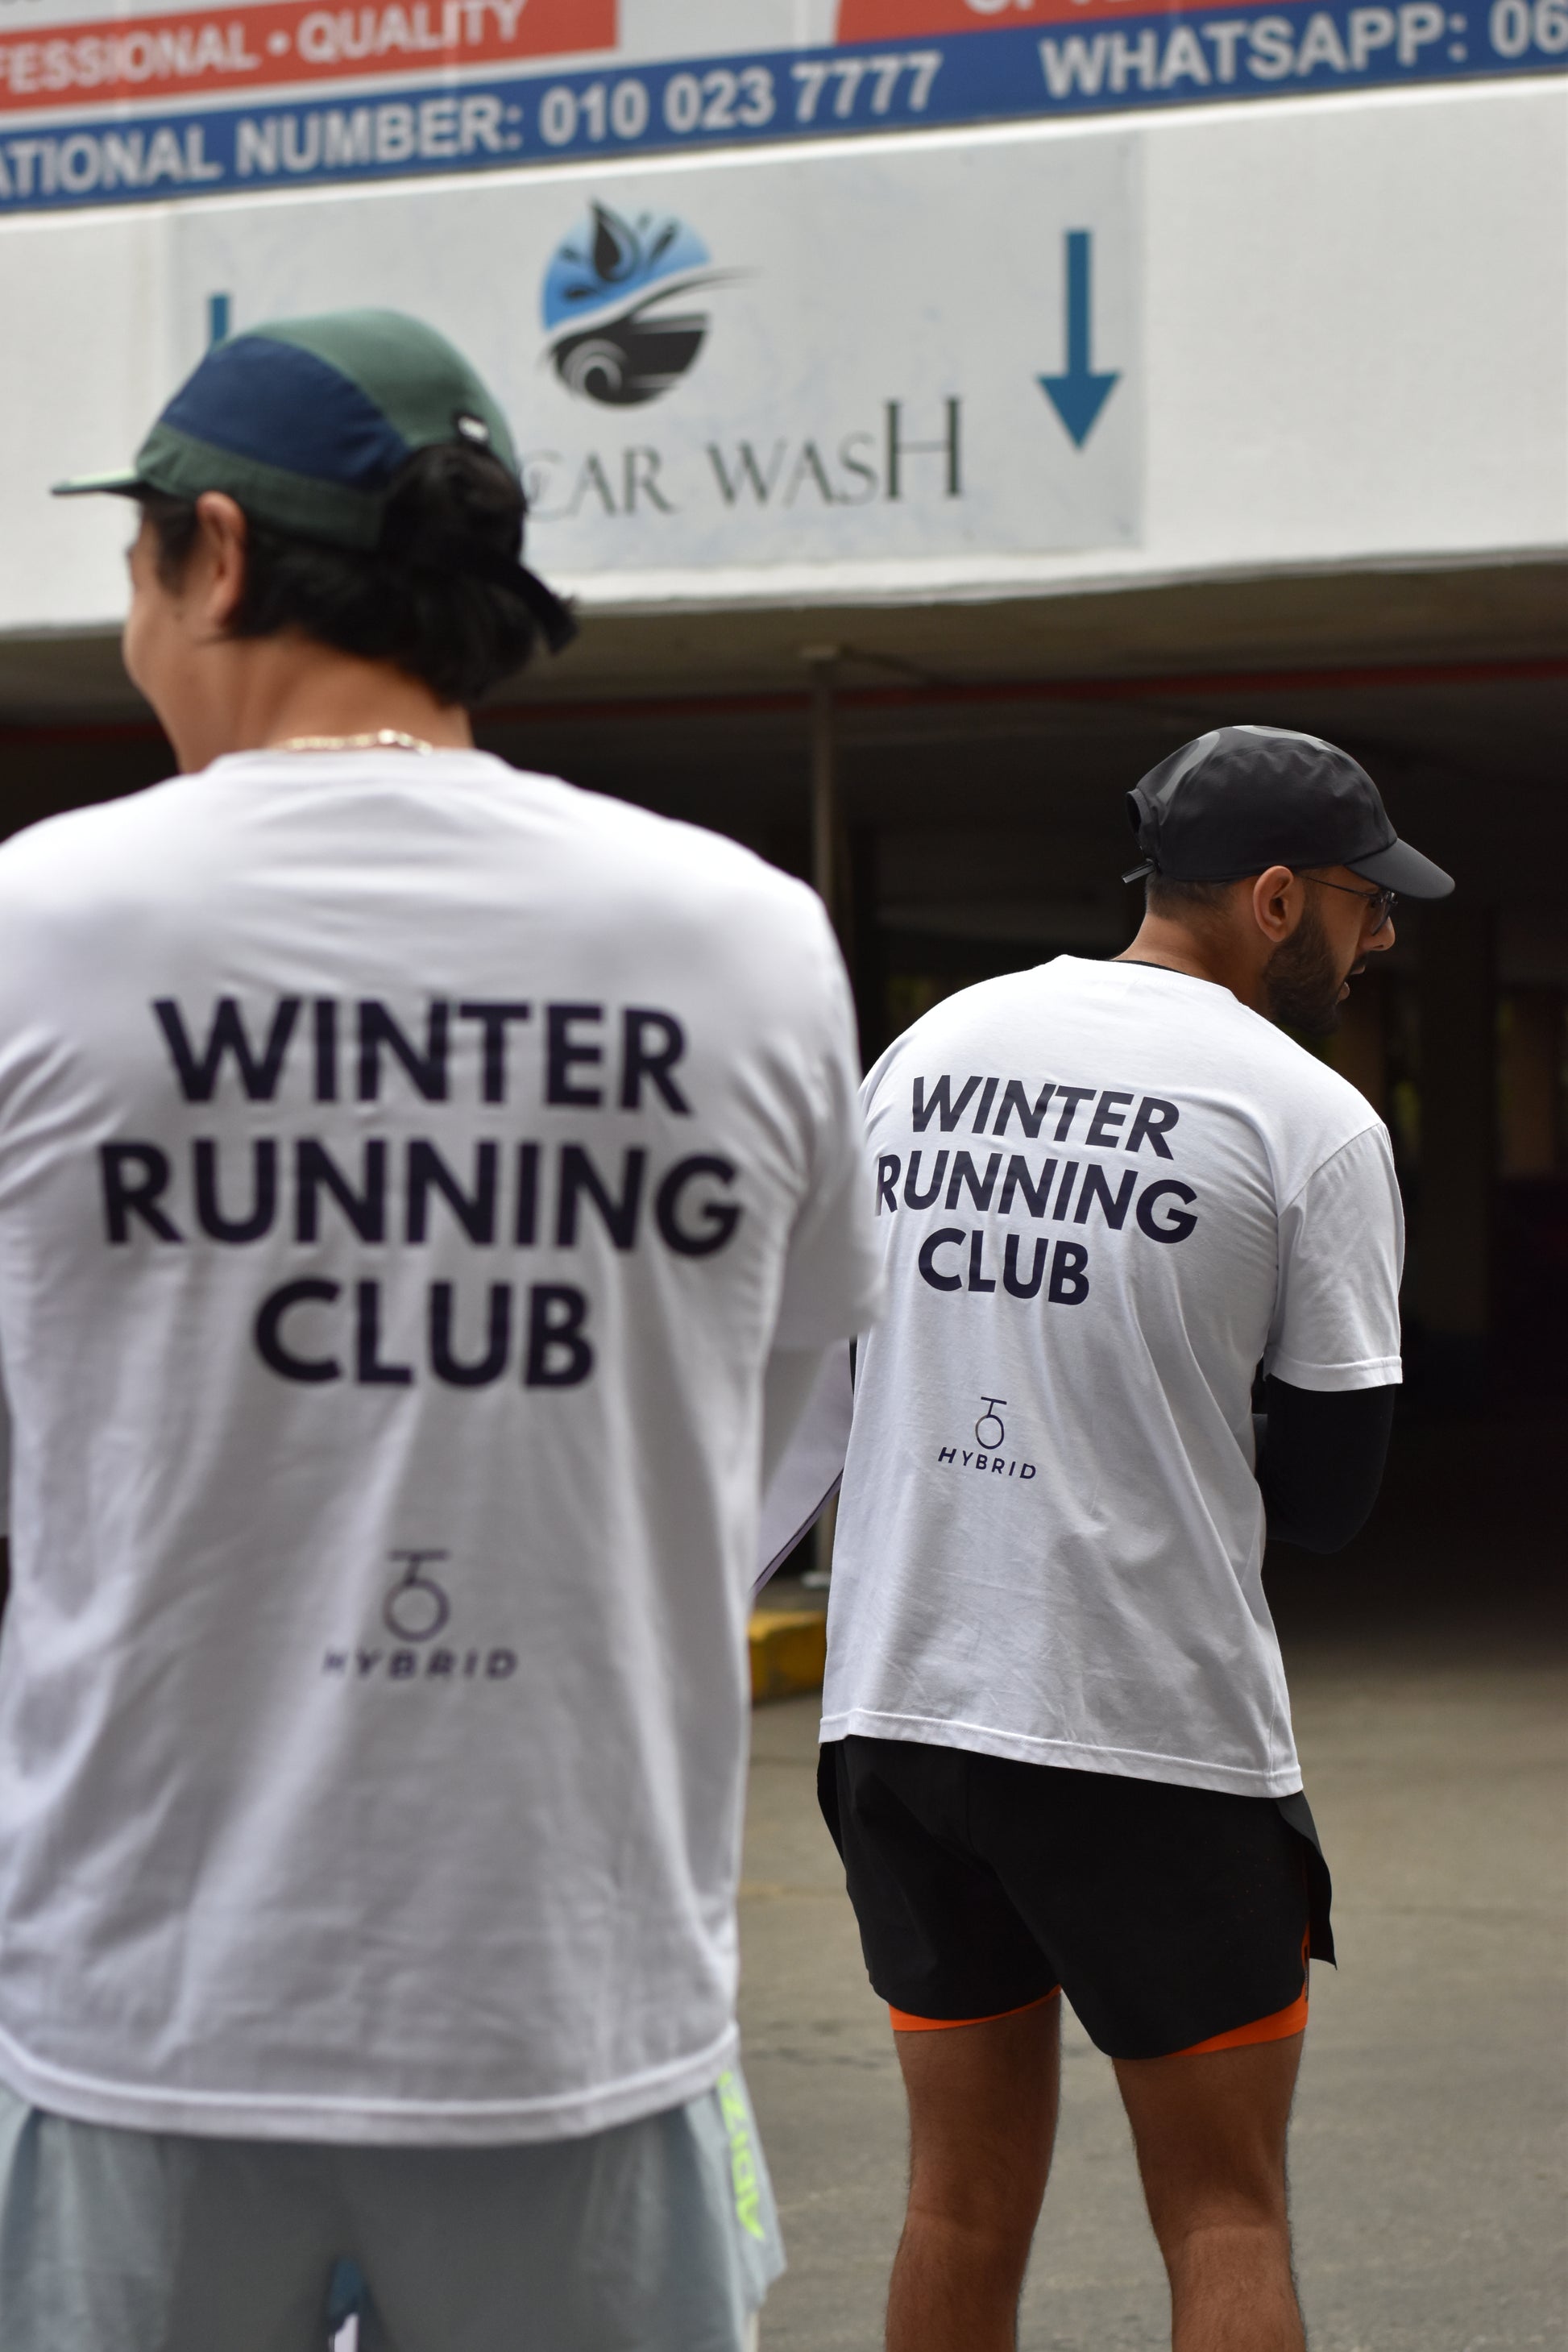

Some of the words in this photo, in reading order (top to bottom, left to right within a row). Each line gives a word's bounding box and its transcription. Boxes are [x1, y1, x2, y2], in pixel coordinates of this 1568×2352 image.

[0, 19, 263, 94] ESSIONAL
[295, 0, 527, 64] QUALITY
[235, 96, 524, 178] NUMBER:
[538, 79, 648, 146] 010
[664, 66, 774, 133] 023
[791, 52, 943, 122] 7777
[1038, 2, 1467, 98] WHATSAPP:
[151, 994, 693, 1117] WINTER
[912, 1074, 1180, 1161] WINTER
[98, 1136, 745, 1258] RUNNING
[875, 1149, 1199, 1245] RUNNING
[918, 1227, 1090, 1306] CLUB
[252, 1276, 595, 1389] CLUB
[938, 1446, 1037, 1480] HYBRID
[322, 1648, 518, 1681] HYBRID
